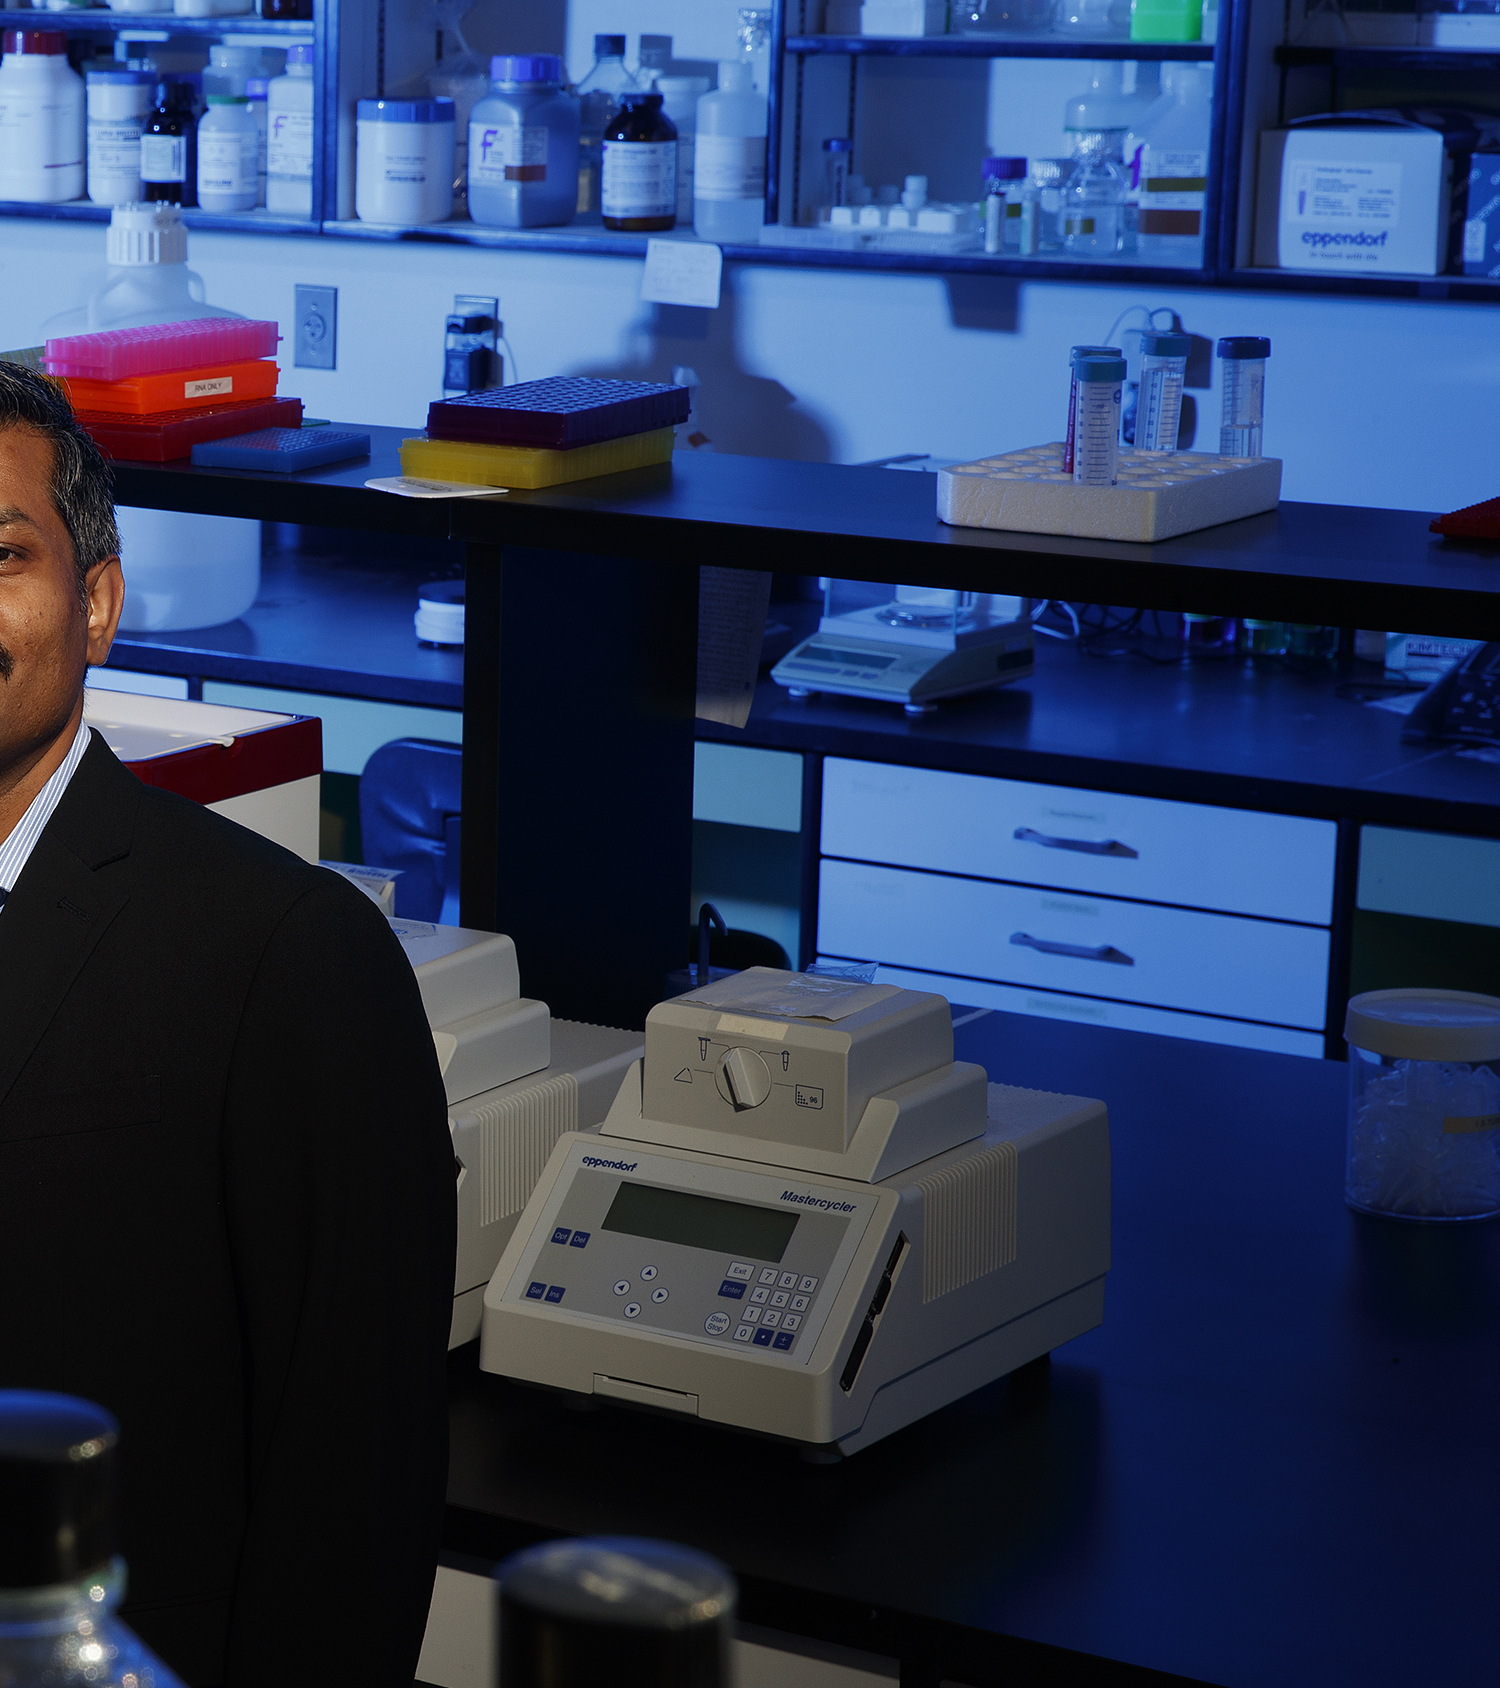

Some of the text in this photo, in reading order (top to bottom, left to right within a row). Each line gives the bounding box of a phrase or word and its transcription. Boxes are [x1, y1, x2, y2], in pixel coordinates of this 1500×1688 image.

[1302, 230, 1388, 248] eppendorf
[195, 382, 222, 392] RNA ONLY
[809, 1096, 818, 1104] 96
[582, 1156, 638, 1172] eppendorf
[780, 1190, 857, 1213] Mastercycler
[555, 1232, 587, 1244] Opt Del
[733, 1266, 748, 1276] Exit
[764, 1272, 812, 1289] 7 8 9
[530, 1286, 560, 1299] Sel Ins
[722, 1285, 742, 1295] Enter
[756, 1291, 804, 1308] 4 5 6
[710, 1315, 728, 1325] Start
[749, 1310, 795, 1327] 1 2 3
[706, 1322, 724, 1333] Stop
[740, 1328, 748, 1338] 0
